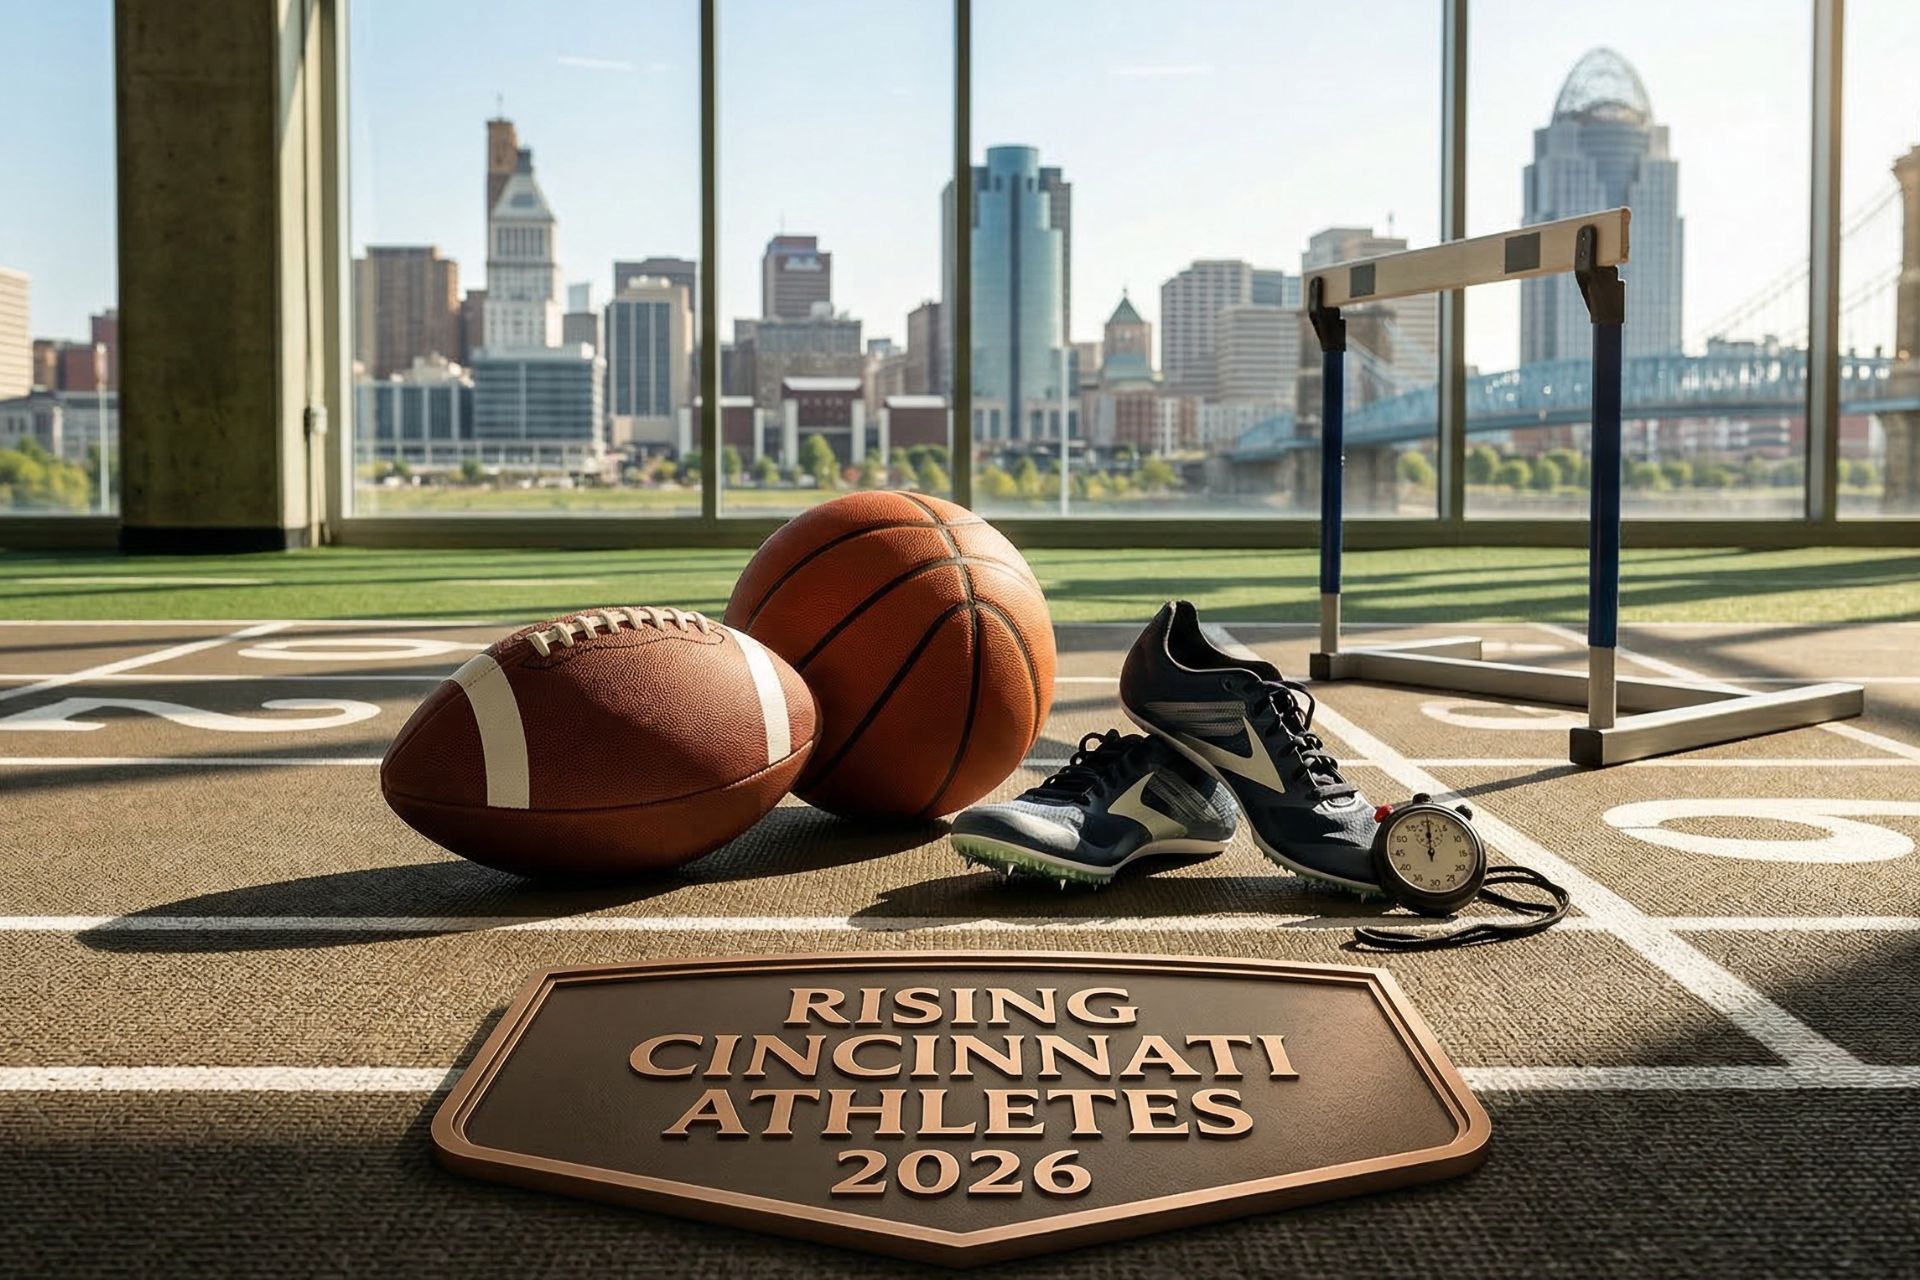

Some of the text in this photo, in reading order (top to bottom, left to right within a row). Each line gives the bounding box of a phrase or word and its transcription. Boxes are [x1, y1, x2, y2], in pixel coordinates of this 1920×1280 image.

[1430, 879, 1441, 887] 30
[1454, 864, 1466, 872] 20
[784, 987, 1139, 1026] RISING
[628, 1033, 1299, 1078] CINCINNATI
[661, 1088, 1254, 1138] ATHLETES
[830, 1149, 1092, 1196] 2026
